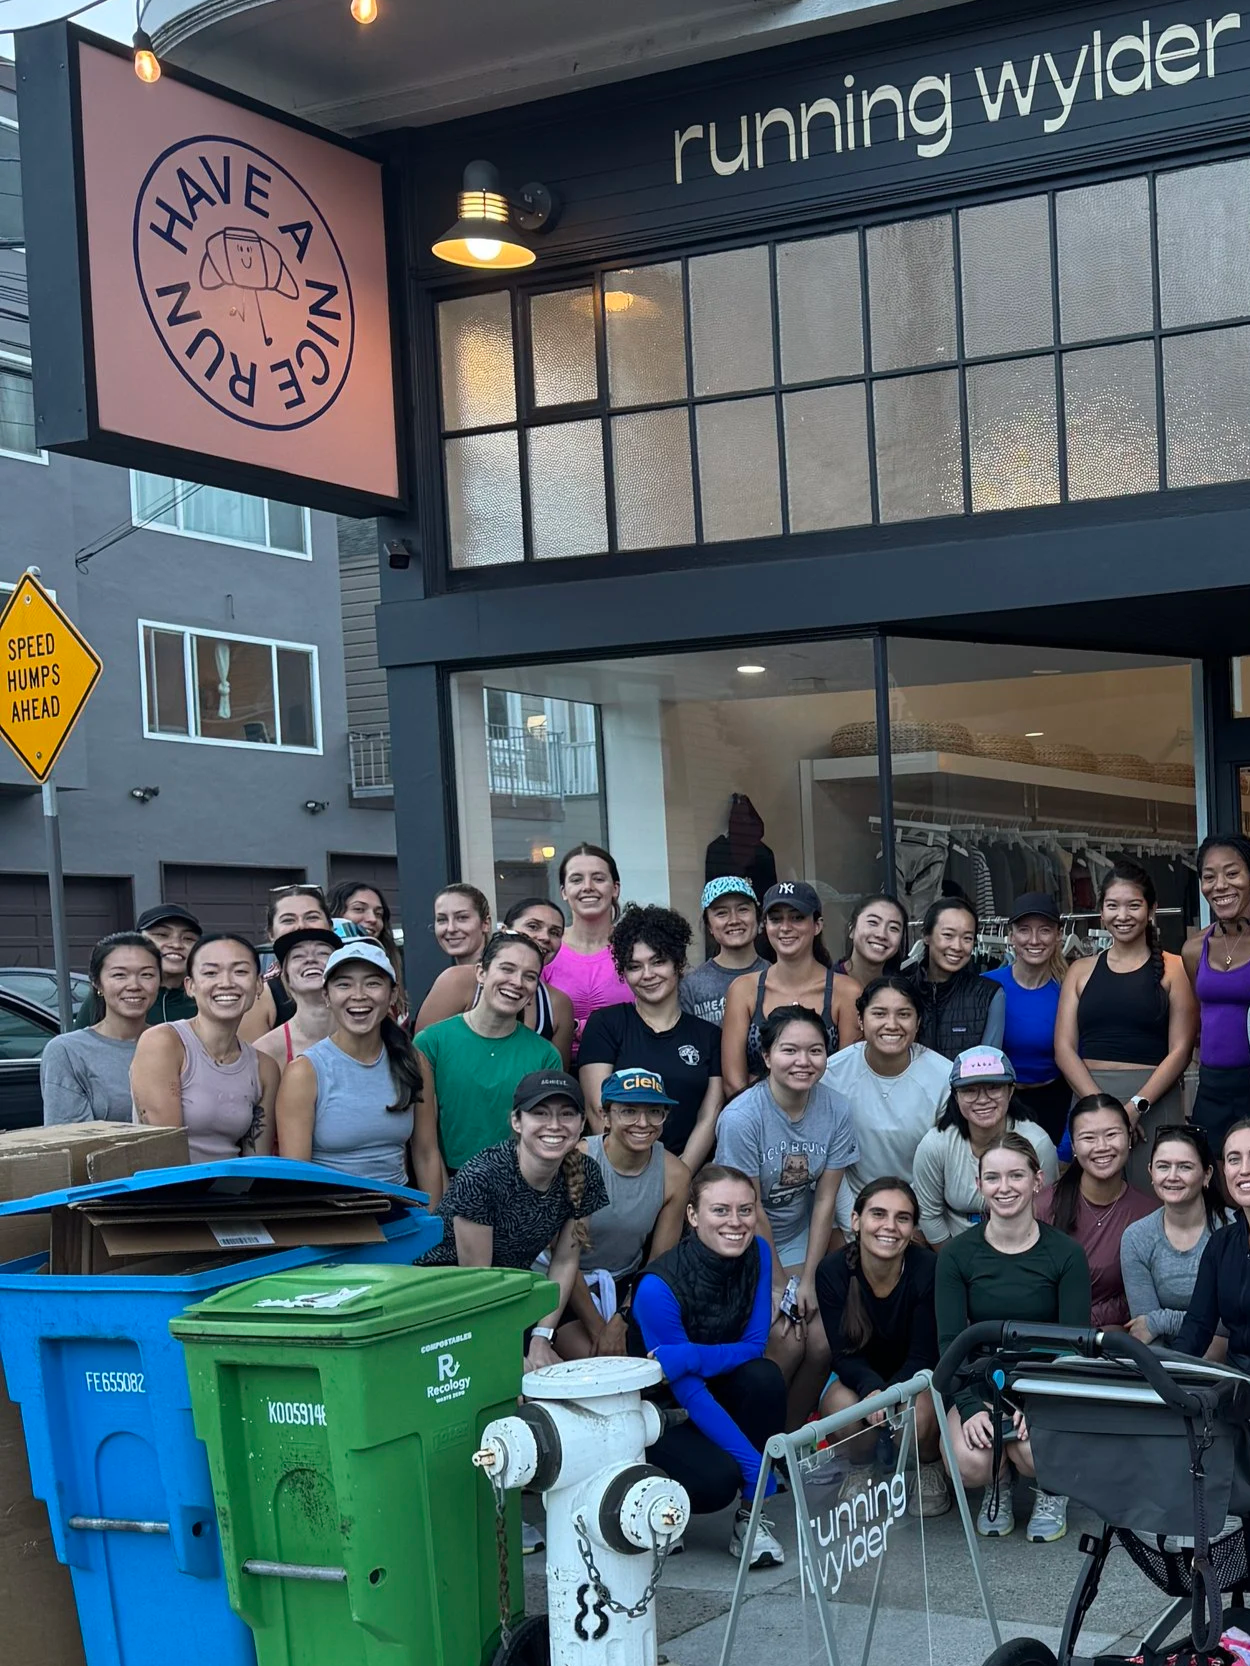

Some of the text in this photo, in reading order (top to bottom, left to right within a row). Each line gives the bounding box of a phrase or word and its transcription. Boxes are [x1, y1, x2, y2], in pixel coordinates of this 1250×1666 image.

[673, 12, 1241, 184] running wylder
[149, 155, 342, 410] HAVE A NICE RUN
[8, 632, 56, 662] SPEED
[7, 663, 61, 693] HUMPS
[11, 695, 61, 724] AHEAD
[623, 1075, 664, 1094] ciele
[420, 1331, 472, 1354] COMPOSTABLES
[85, 1371, 146, 1393] FE655082
[427, 1376, 471, 1398] Recology
